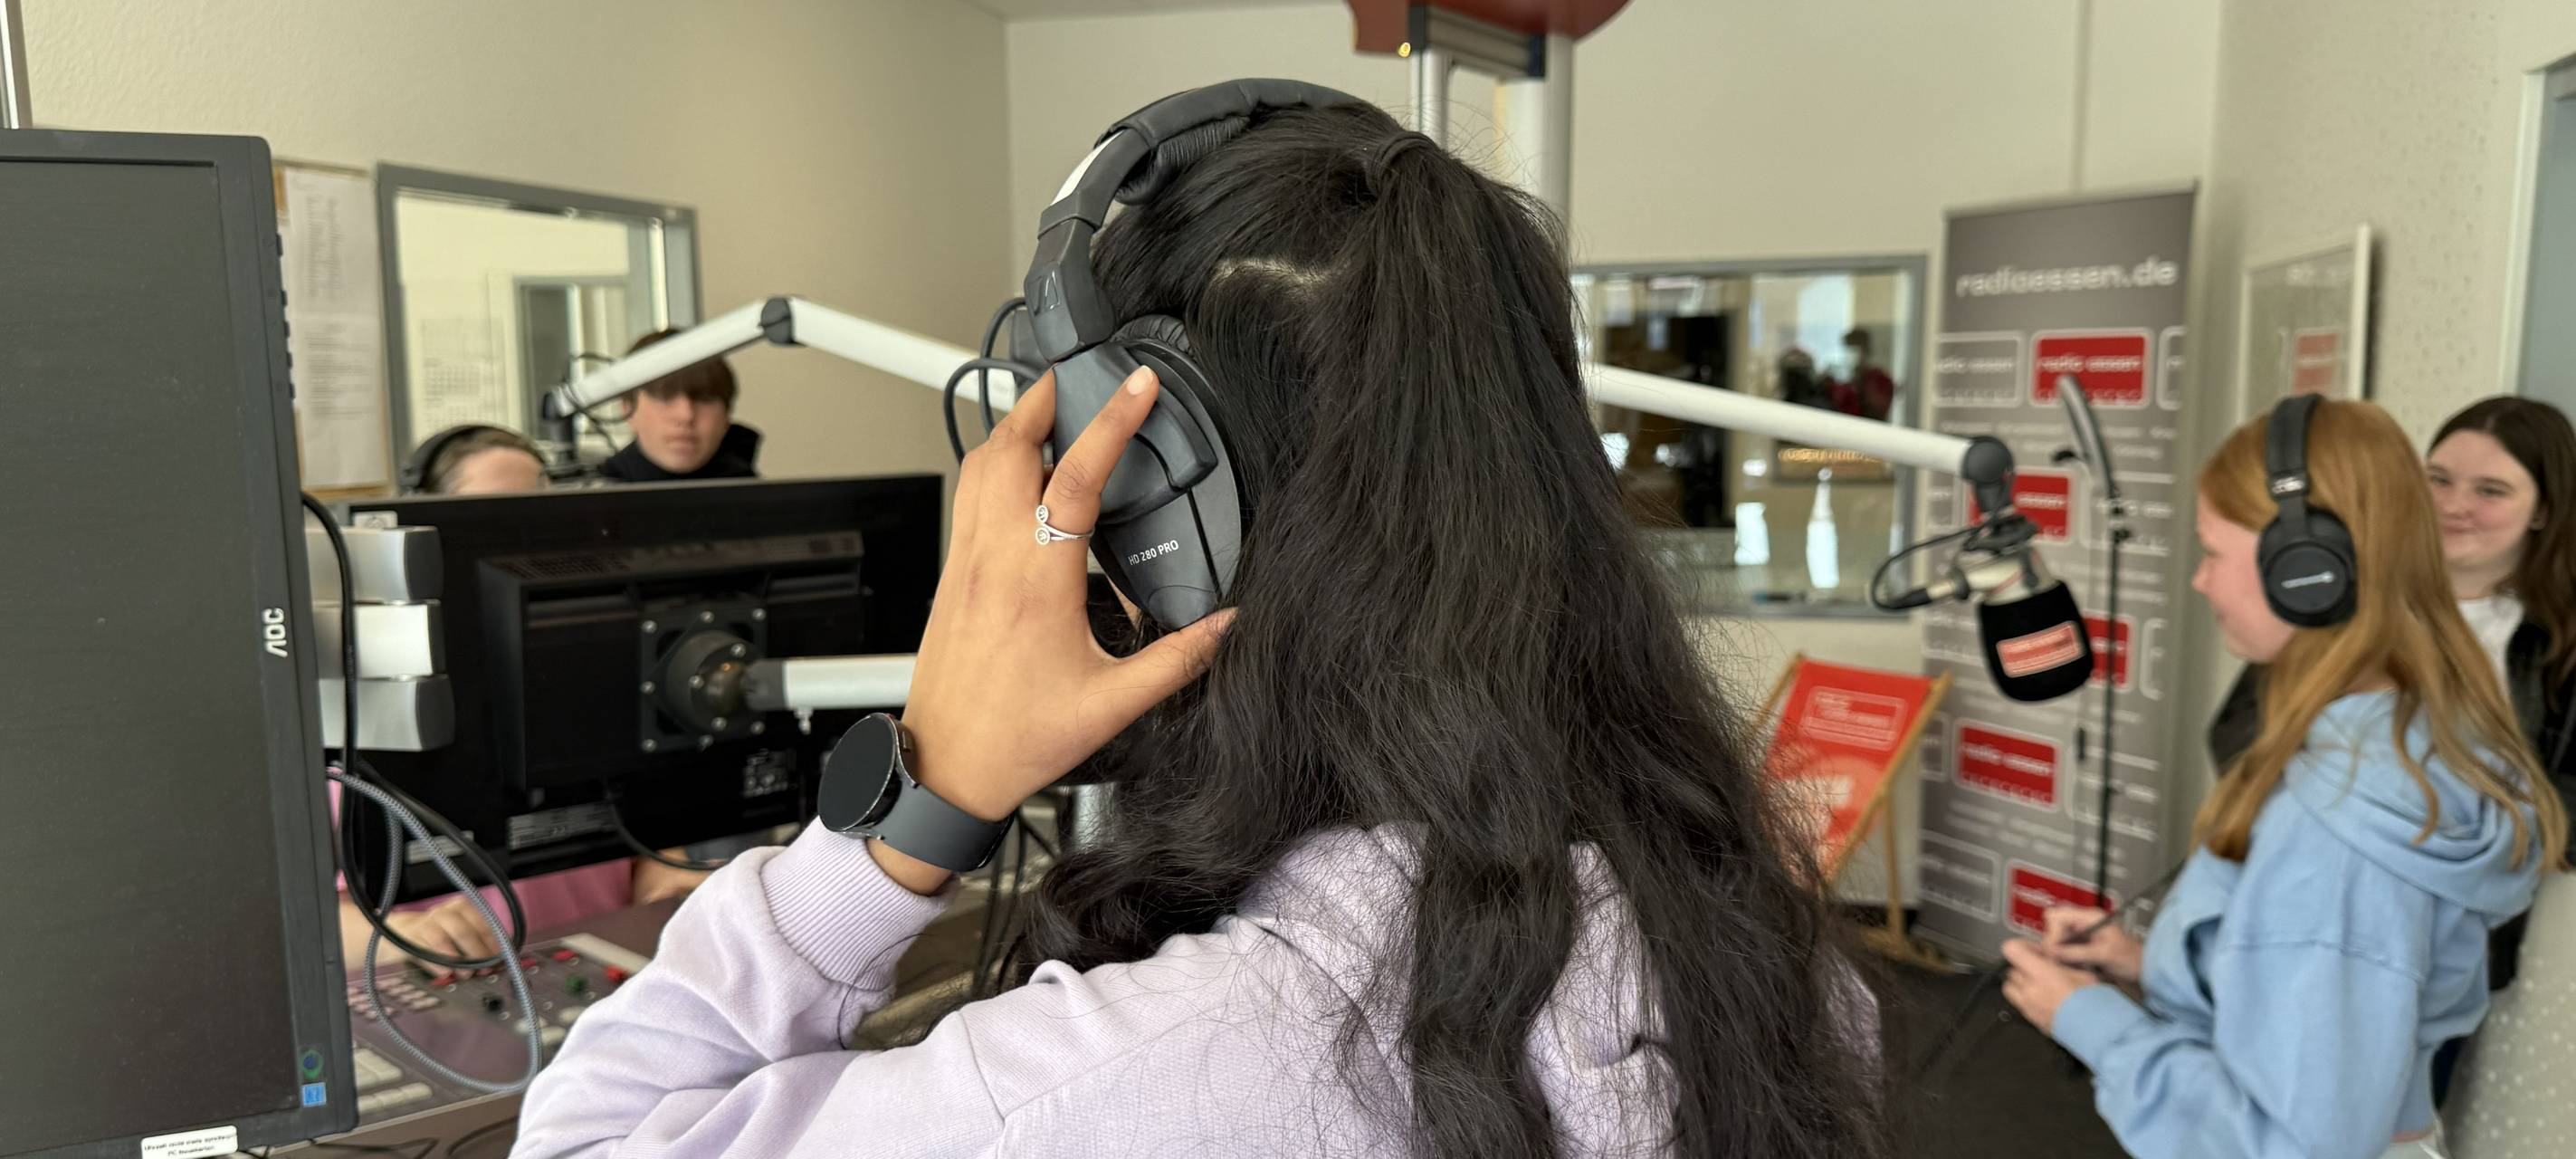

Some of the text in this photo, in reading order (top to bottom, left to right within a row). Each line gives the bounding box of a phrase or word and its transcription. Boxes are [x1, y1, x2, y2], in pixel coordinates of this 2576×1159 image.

[1956, 254, 2178, 297] radioessen.de
[1128, 540, 1179, 566] HD 280 PRO
[262, 608, 288, 657] AOC
